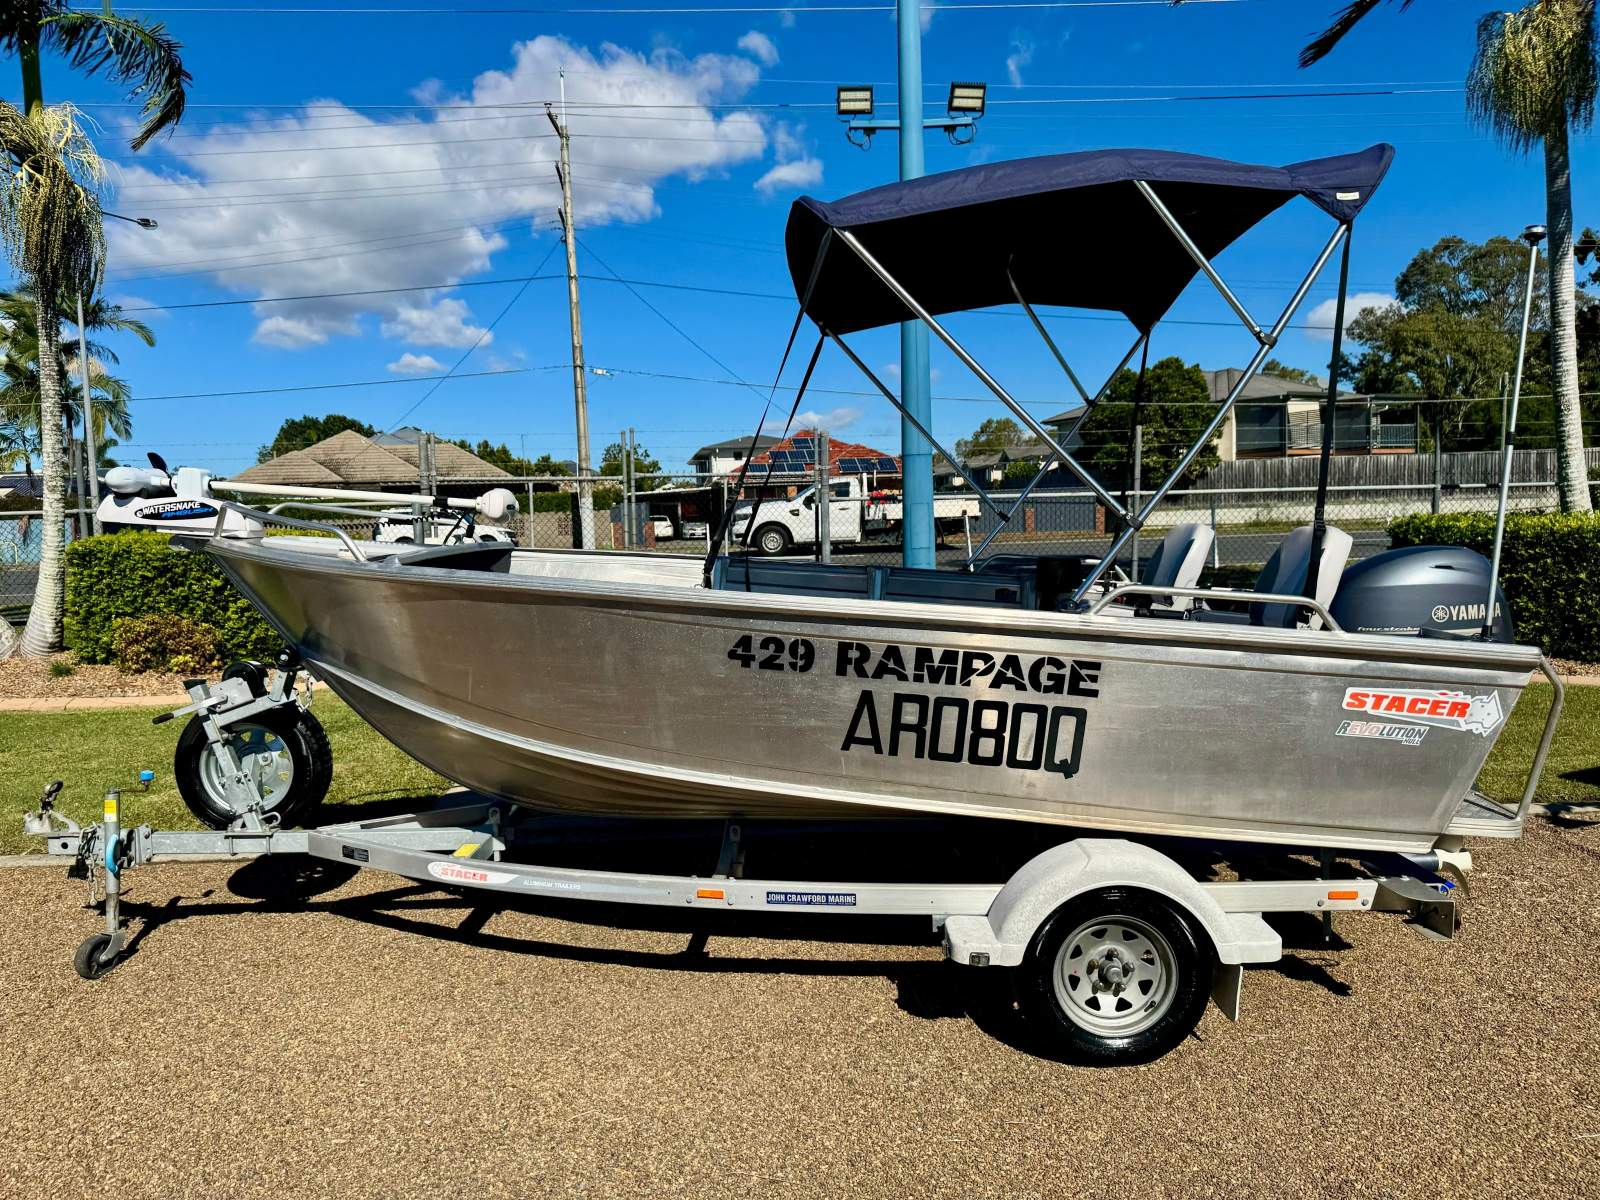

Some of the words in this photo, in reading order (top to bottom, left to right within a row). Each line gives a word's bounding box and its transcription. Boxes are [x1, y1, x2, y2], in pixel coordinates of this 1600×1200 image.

[142, 502, 201, 515] WATERSNAKE
[1449, 602, 1502, 621] YAMAA
[727, 634, 815, 673] 429
[835, 641, 1102, 698] RAMPAGE
[1345, 692, 1471, 719] STACER
[1337, 721, 1428, 739] REVOLUTION
[440, 867, 489, 882] STACER
[767, 893, 785, 902] JOHN
[787, 894, 826, 903] CRAWFORD
[828, 895, 856, 904] MARINE
